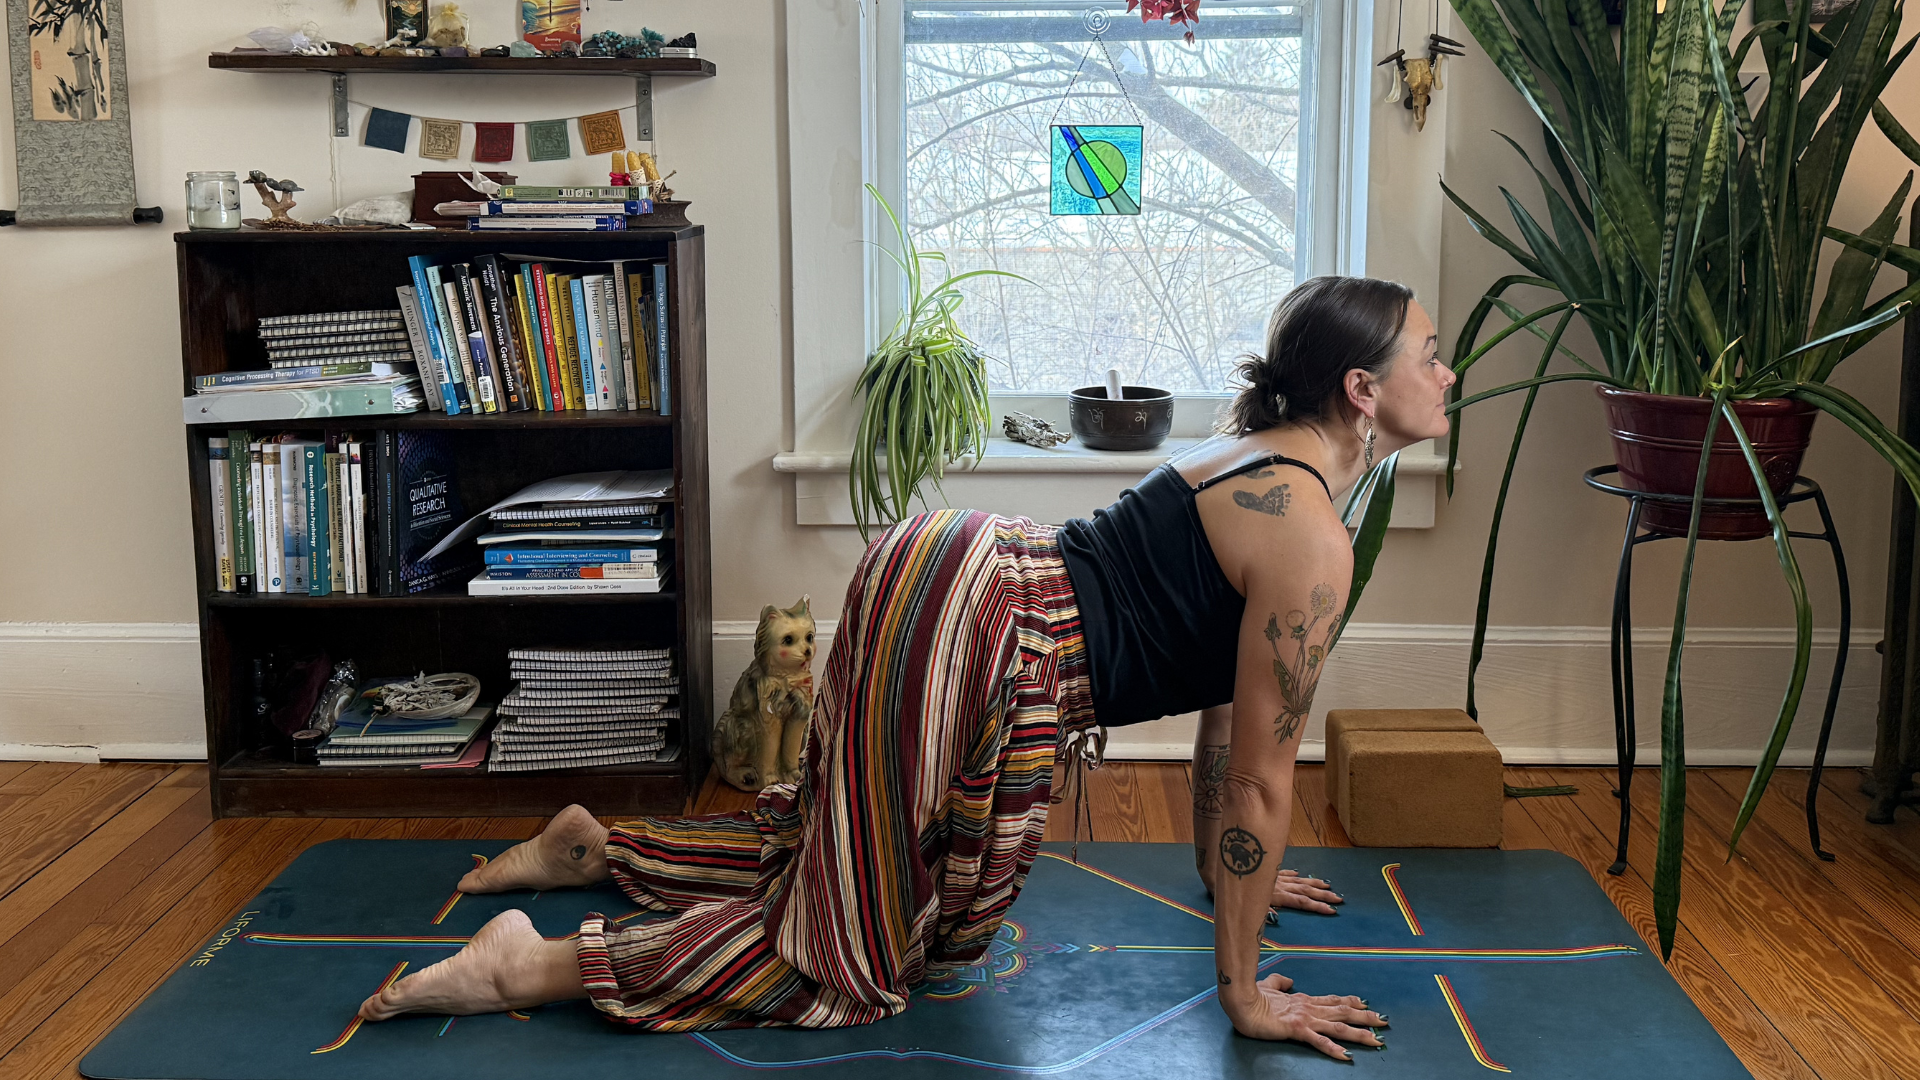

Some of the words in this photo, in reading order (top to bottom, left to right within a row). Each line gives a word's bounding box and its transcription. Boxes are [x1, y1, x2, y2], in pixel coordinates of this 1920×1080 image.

[460, 274, 472, 301] Authentic
[486, 263, 497, 291] Jonathan
[535, 269, 543, 295] RETURNING
[604, 278, 614, 299] HAND
[615, 265, 626, 311] MINDFULNESS
[437, 301, 446, 316] OUR
[465, 301, 479, 330] Movement
[490, 297, 499, 313] The
[591, 288, 603, 338] Humankind
[607, 304, 618, 330] MOUTH
[405, 304, 418, 338] HUNGER
[440, 315, 456, 354] POLYVAGAL
[493, 314, 505, 346] Anxious
[567, 335, 577, 358] REFUGE
[222, 375, 245, 383] Cognitive
[246, 371, 274, 380] Processing
[275, 369, 295, 378] Therapy
[305, 367, 320, 375] PTSD
[417, 349, 431, 381] ROXANE
[426, 382, 435, 398] GAY
[449, 354, 462, 379] WORLD
[500, 346, 515, 392] Generation
[570, 359, 581, 389] RECOVERY
[409, 481, 448, 502] QUALITATIVE
[412, 497, 446, 517] RESEARCH
[309, 516, 317, 547] Psychology
[589, 551, 618, 559] Counseling
[190, 910, 260, 967] LIFORME
